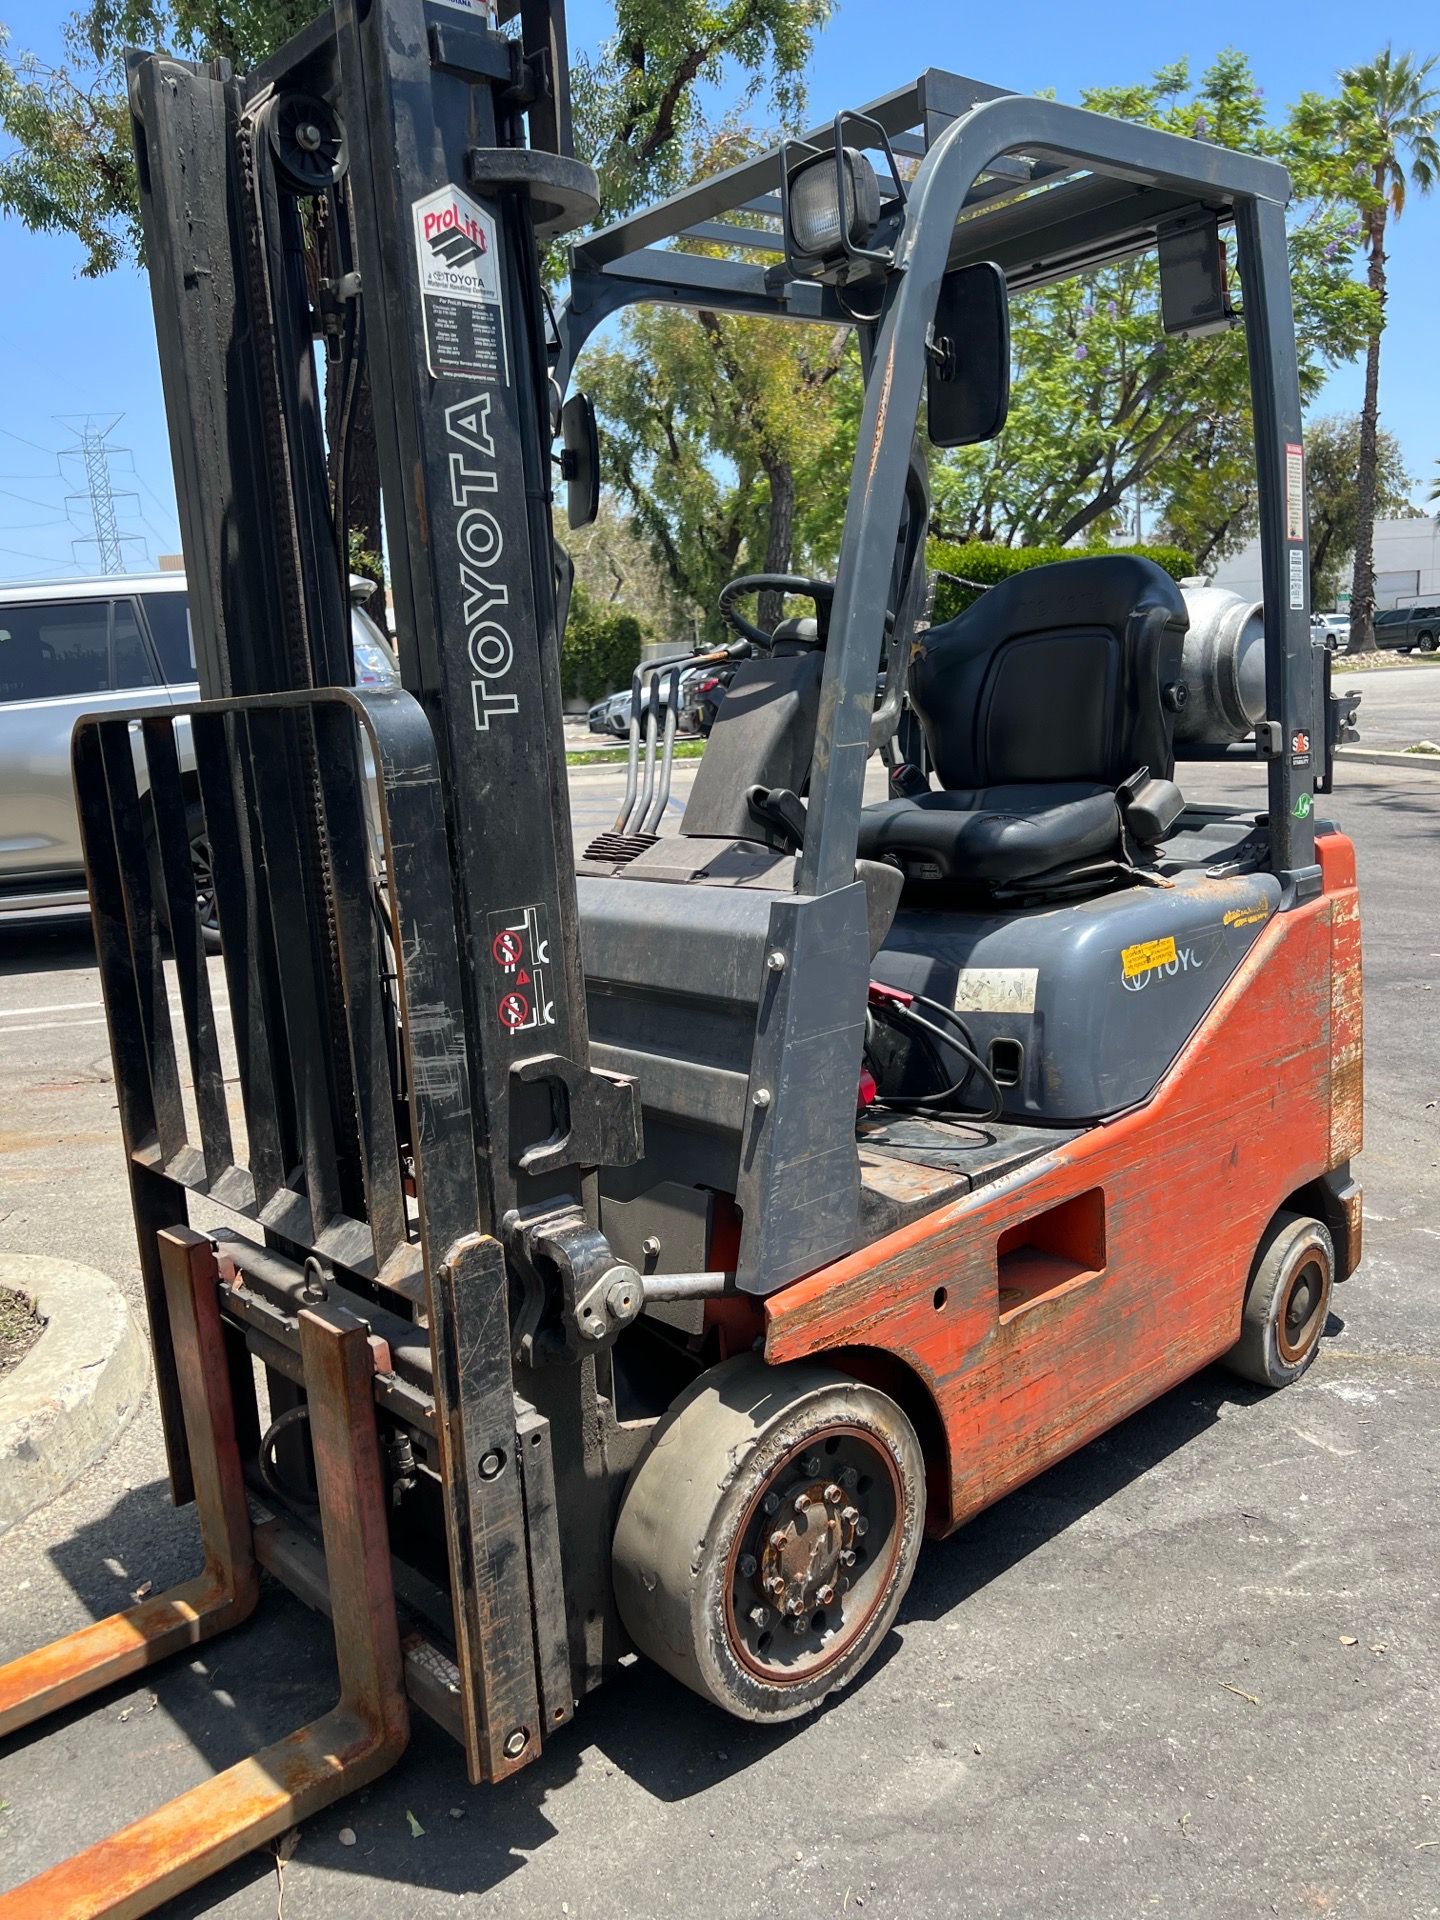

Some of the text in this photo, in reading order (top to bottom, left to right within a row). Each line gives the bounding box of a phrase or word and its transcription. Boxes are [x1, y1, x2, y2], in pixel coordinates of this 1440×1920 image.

[424, 203, 487, 253] ProLift
[427, 280, 448, 289] Material
[473, 286, 495, 297] Company
[443, 272, 486, 289] TOYOTA
[444, 391, 519, 731] TOYOTA
